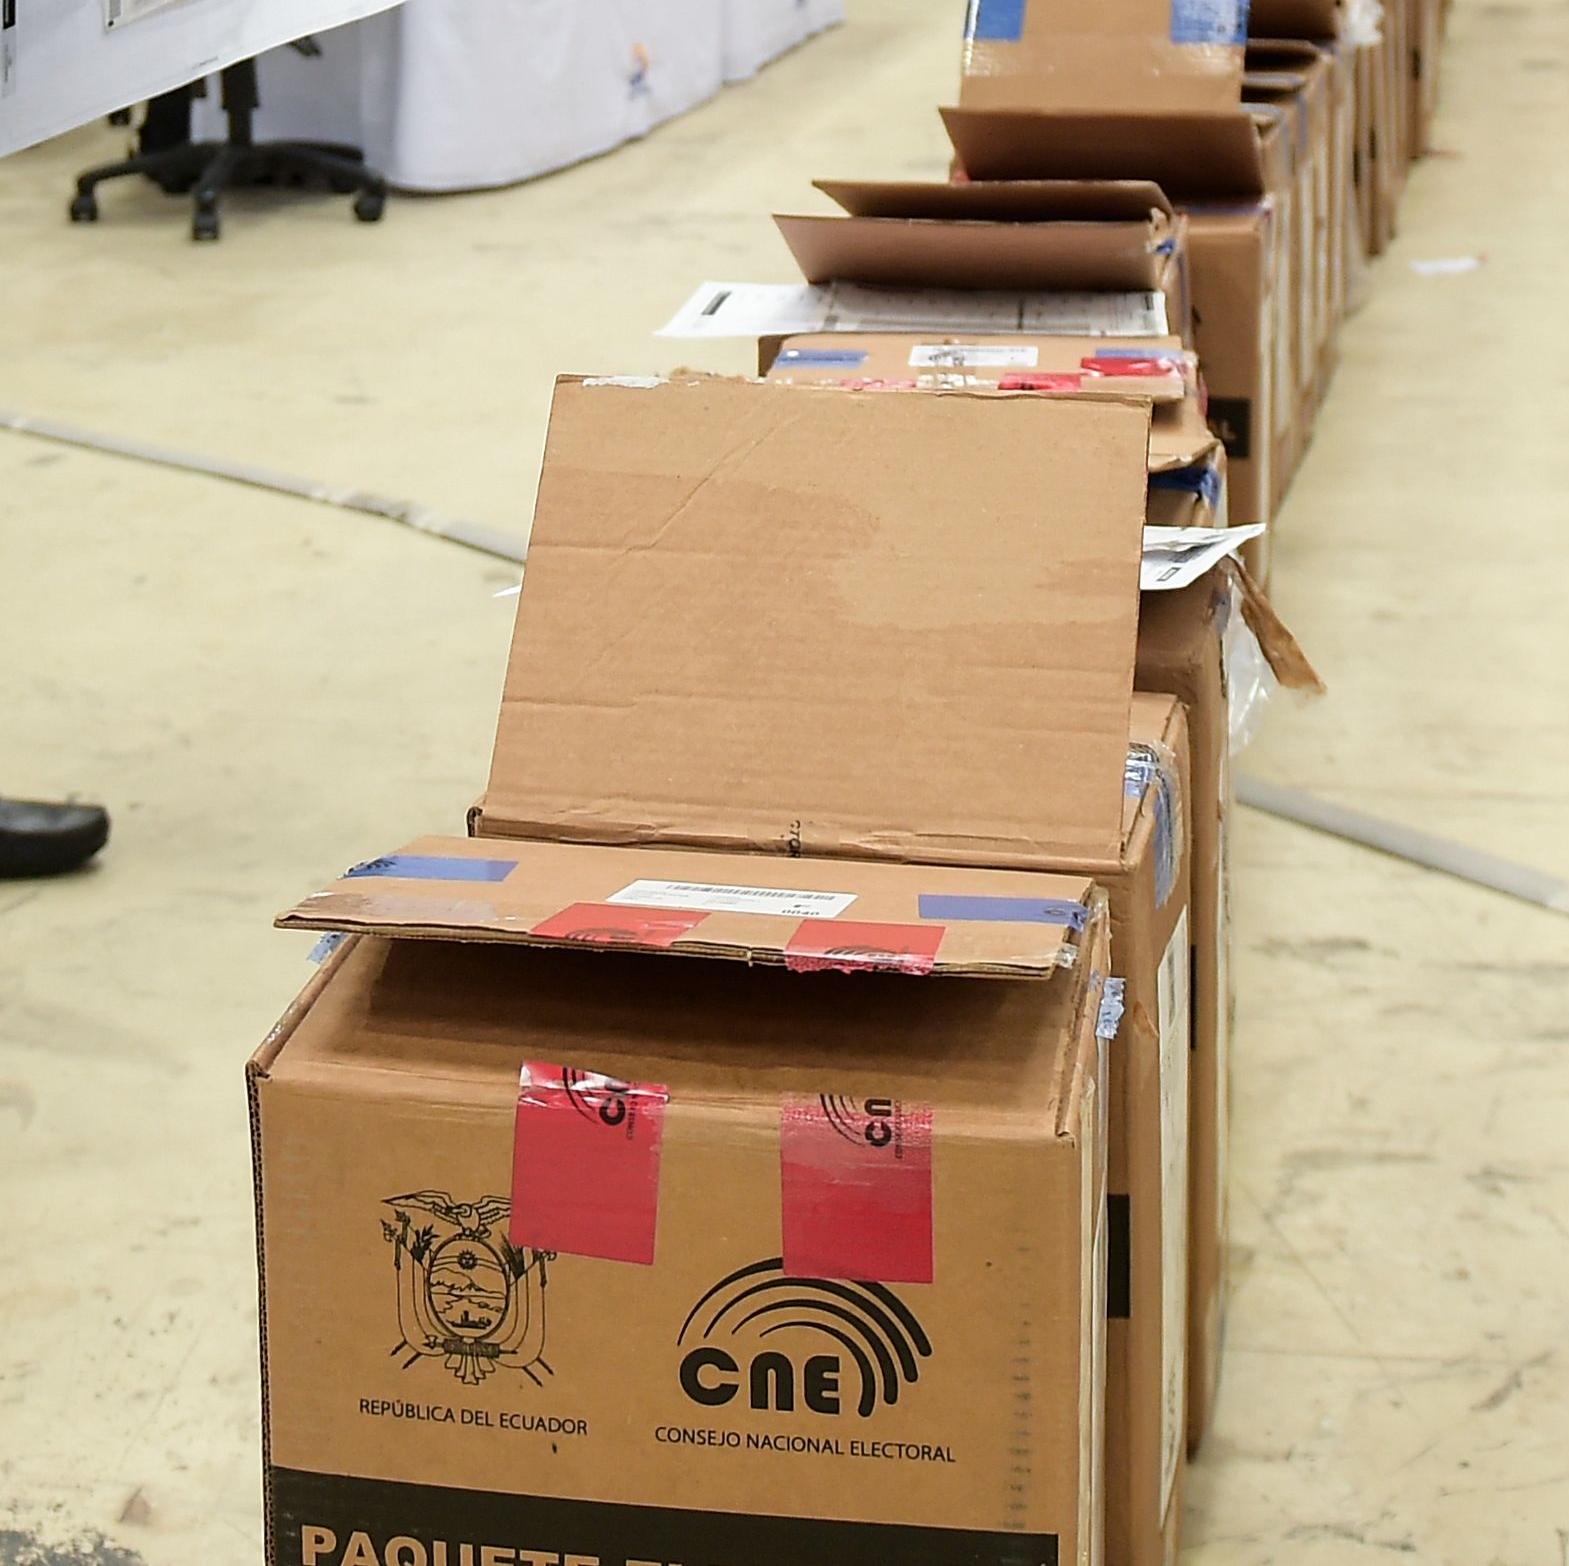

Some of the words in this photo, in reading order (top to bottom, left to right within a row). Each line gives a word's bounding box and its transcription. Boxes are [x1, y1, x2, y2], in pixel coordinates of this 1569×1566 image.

[679, 1345, 841, 1417] CNE
[359, 1398, 455, 1424] REPÚBLICA
[460, 1410, 495, 1426] DEL
[499, 1413, 588, 1436] ECUADOR
[654, 1426, 741, 1448] CONSEJO
[746, 1433, 844, 1455] NACIONAL
[849, 1441, 956, 1463] ELECTORAL
